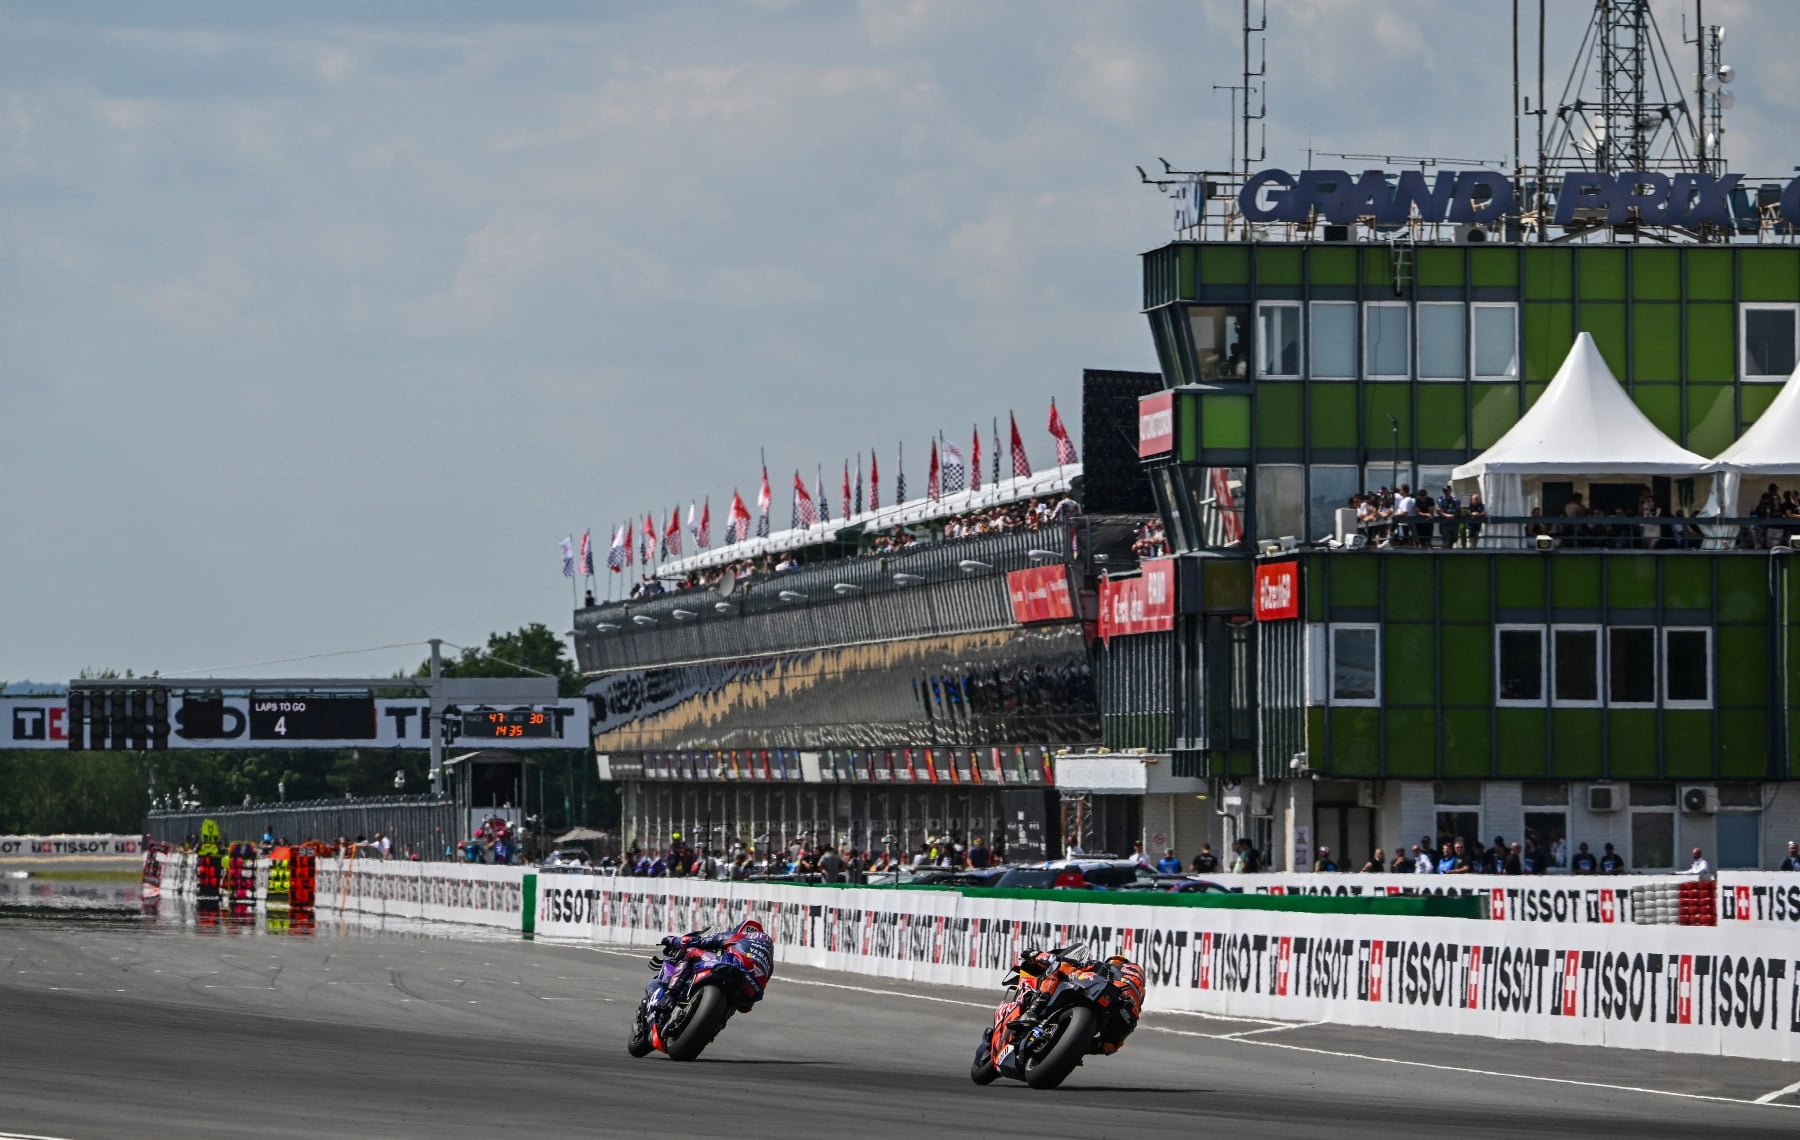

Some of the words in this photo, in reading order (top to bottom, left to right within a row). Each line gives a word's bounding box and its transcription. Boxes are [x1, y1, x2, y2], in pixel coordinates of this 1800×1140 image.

[1238, 168, 1515, 224] GRAND
[1554, 171, 1746, 226] PRIX
[255, 702, 278, 712] LAPS
[279, 702, 291, 712] TO
[292, 702, 306, 712] GO
[489, 712, 505, 724] 47
[529, 712, 545, 725] 30
[274, 715, 287, 736] 4
[385, 706, 575, 740] TIT
[54, 841, 109, 854] TISSOT
[1506, 888, 1581, 923] TISSOT
[1212, 933, 1267, 994] TISSOT
[1293, 937, 1354, 1000] TISSOT
[1385, 940, 1458, 1007] TISSOT
[1482, 946, 1549, 1014] TISSOT
[1581, 951, 1663, 1022] TISSOT
[1694, 955, 1786, 1030] TISSOT
